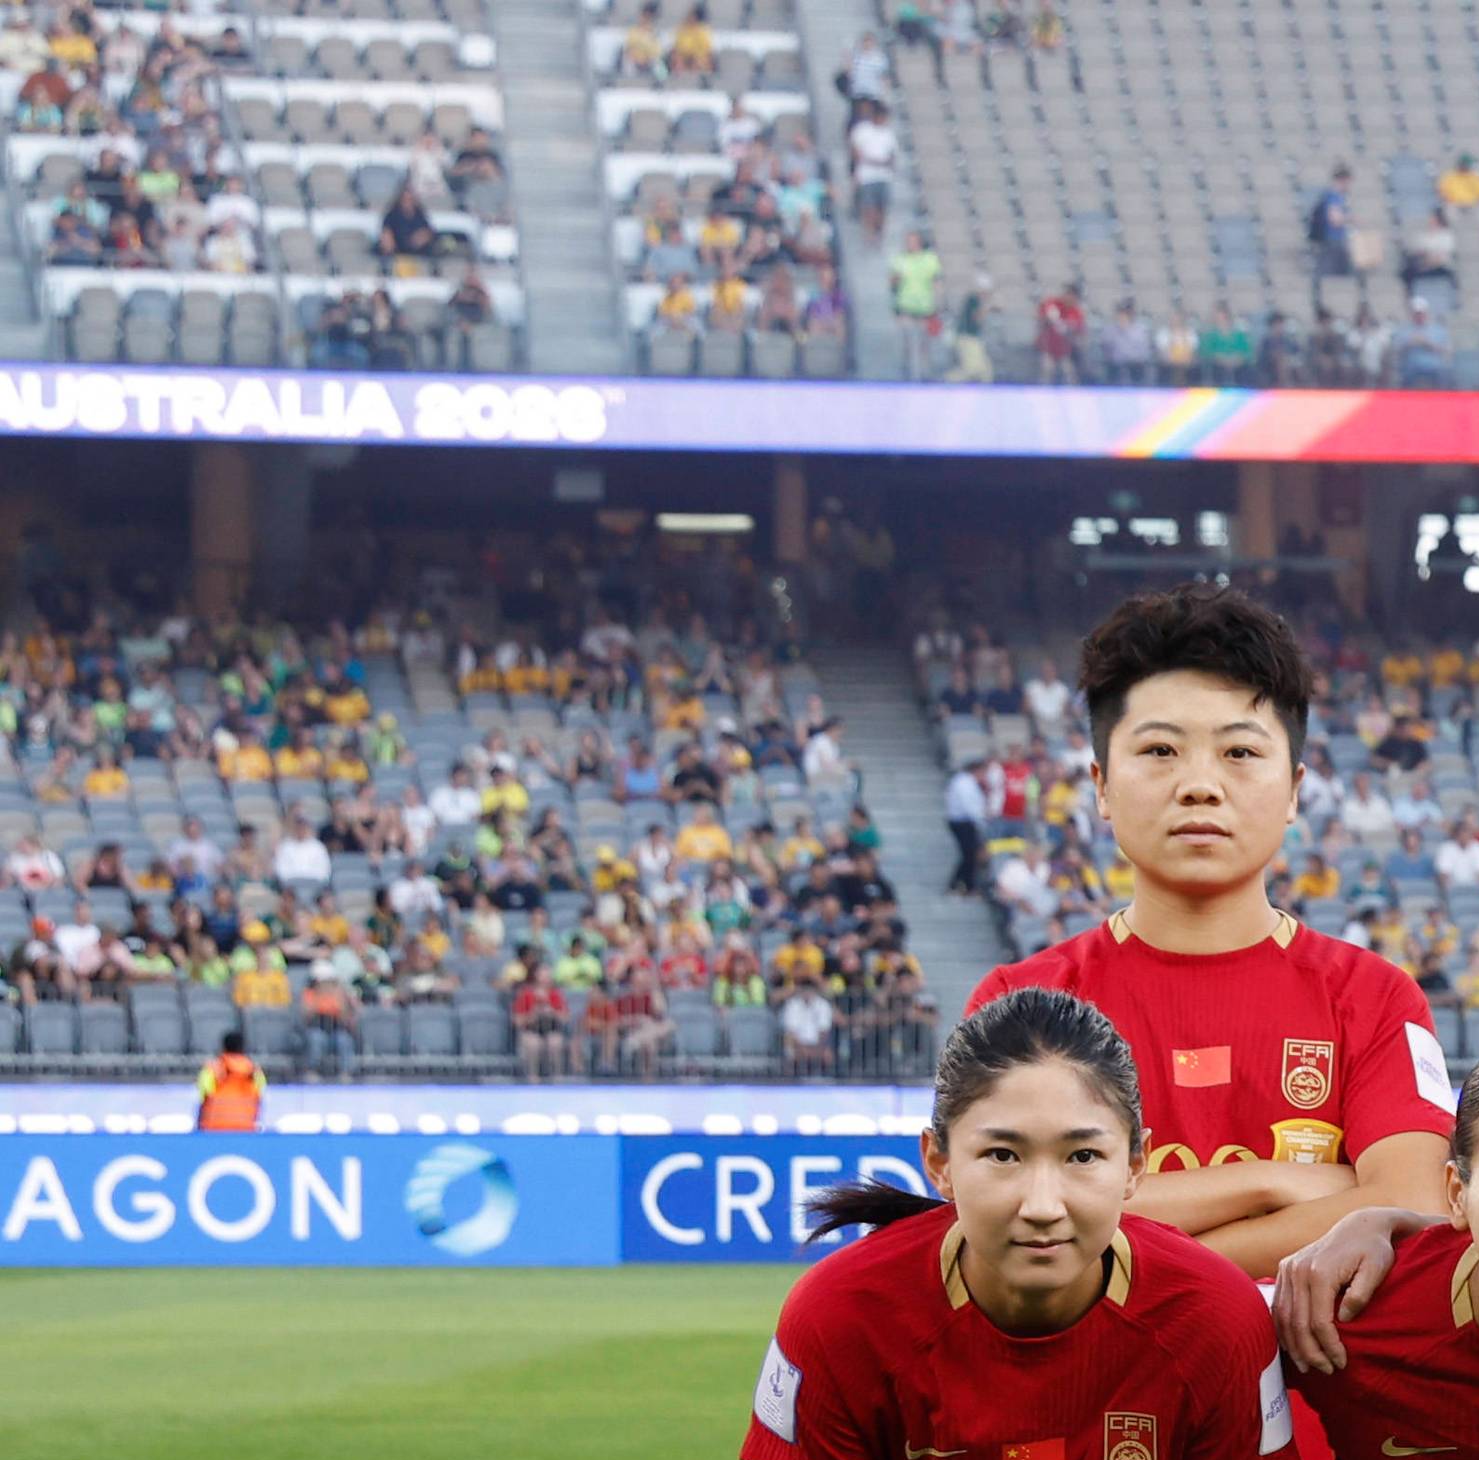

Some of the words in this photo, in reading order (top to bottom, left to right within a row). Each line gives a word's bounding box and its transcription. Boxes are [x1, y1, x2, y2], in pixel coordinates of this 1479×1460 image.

[1288, 1043, 1329, 1059] CFA
[3, 1154, 363, 1242] AGON
[1109, 1416, 1152, 1432] CFA
